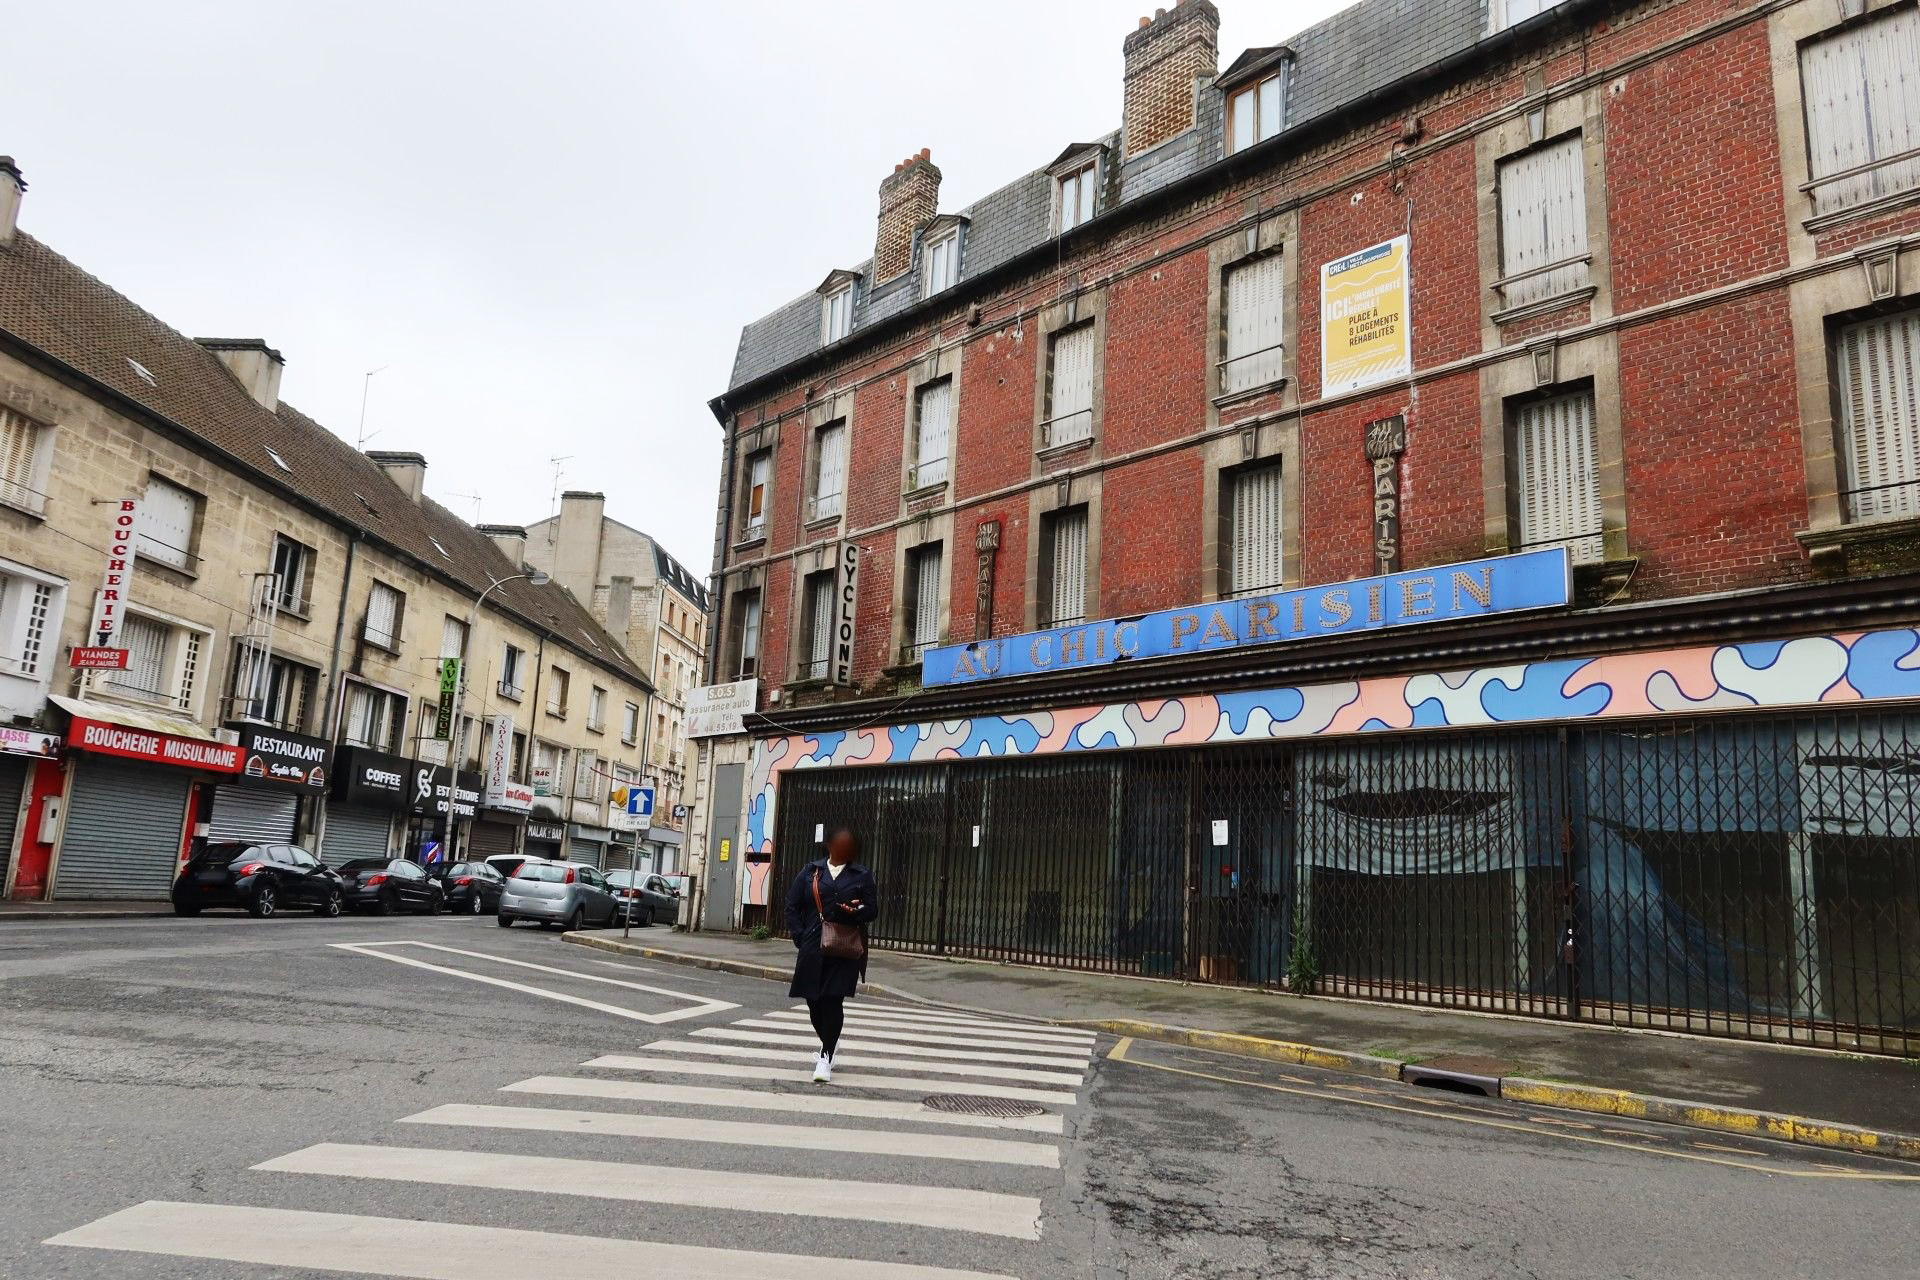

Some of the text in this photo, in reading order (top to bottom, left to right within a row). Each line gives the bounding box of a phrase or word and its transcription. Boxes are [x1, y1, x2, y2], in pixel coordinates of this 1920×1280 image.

[1326, 297, 1349, 322] ICI
[1348, 311, 1371, 325] PLACE
[1349, 313, 1399, 336] 8 LOGEMENTS
[1349, 325, 1395, 347] RÉHABILITÉS
[100, 500, 135, 631] BOUCHERIE
[838, 546, 856, 683] CYCLONE
[952, 567, 1494, 678] AU CHIC PARISIEN
[78, 659, 95, 667] JEAN
[80, 650, 120, 660] VIANDES
[443, 659, 456, 690] AVM
[709, 686, 735, 699] S.O.S.
[437, 692, 453, 737] TISSUS
[690, 700, 750, 714] assurance auto
[84, 725, 237, 768] BOUCHERIE MUSULMANE
[252, 735, 326, 763] RESTAURANT
[366, 768, 402, 786] COFFEE
[436, 785, 479, 803] ESTÉTIQUE
[437, 800, 475, 816] COFFURE
[527, 823, 547, 838] MALAK
[551, 828, 563, 840] BAR
